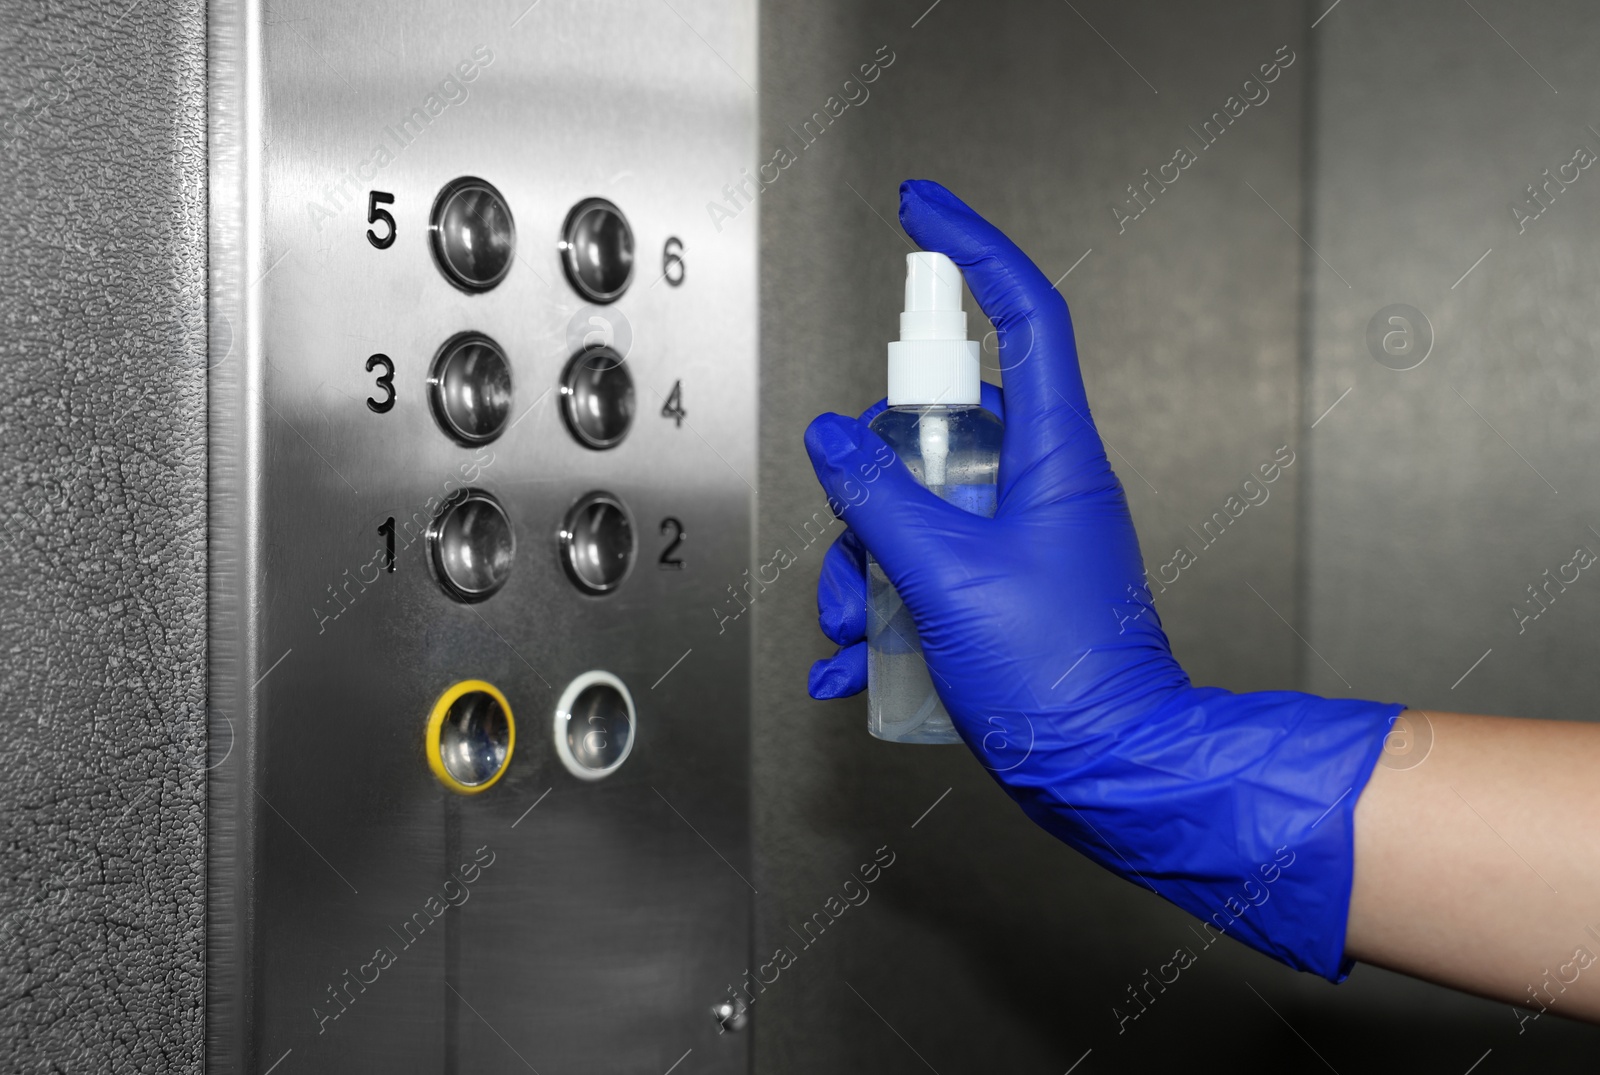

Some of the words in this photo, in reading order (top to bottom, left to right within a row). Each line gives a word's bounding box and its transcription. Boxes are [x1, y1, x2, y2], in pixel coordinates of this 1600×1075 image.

[367, 190, 397, 250] 5
[662, 235, 686, 288] 6
[366, 353, 396, 414] 3
[660, 379, 687, 428] 4
[378, 516, 396, 574] 1
[658, 516, 686, 571] 2
